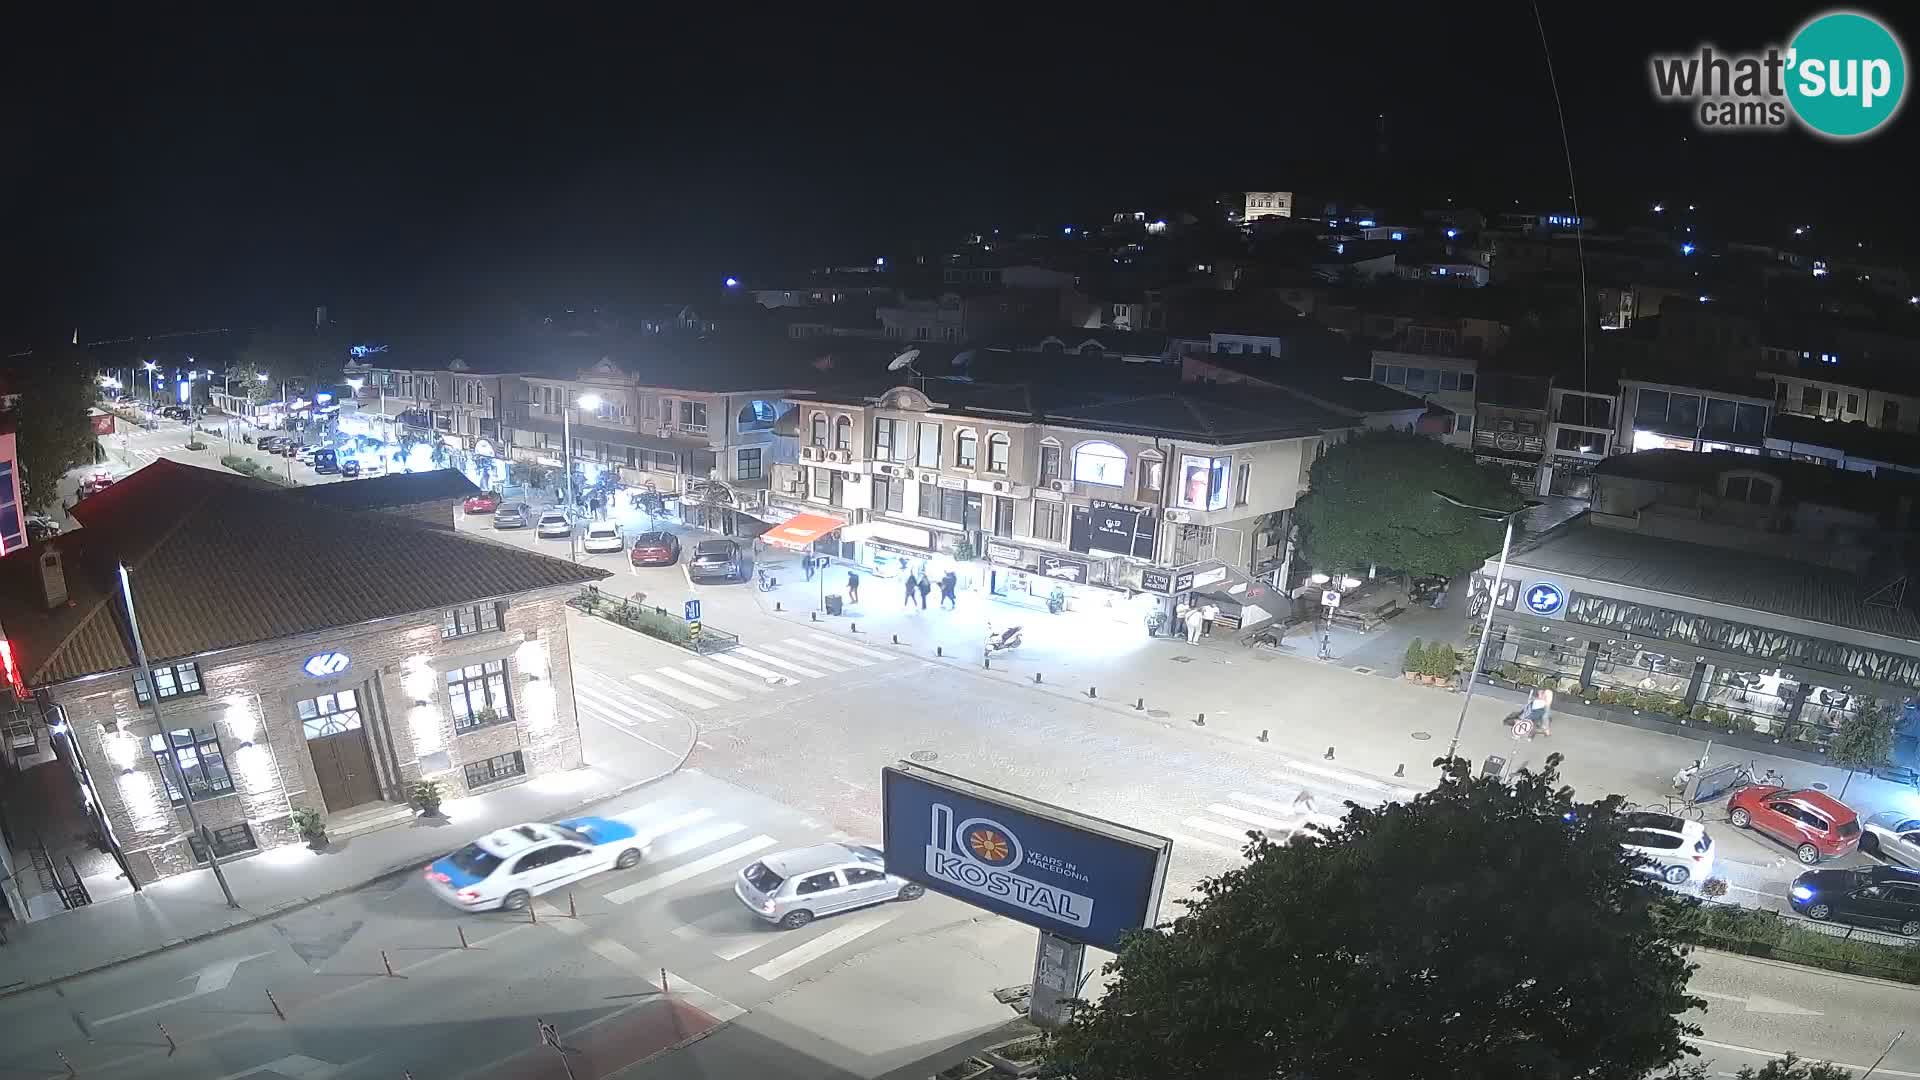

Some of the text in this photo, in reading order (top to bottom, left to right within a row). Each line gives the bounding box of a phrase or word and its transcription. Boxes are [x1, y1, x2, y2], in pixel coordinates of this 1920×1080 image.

[1026, 857, 1089, 883] MACEDONIA
[1028, 850, 1077, 871] YEARS IN
[934, 853, 1080, 921] KOSTAL
